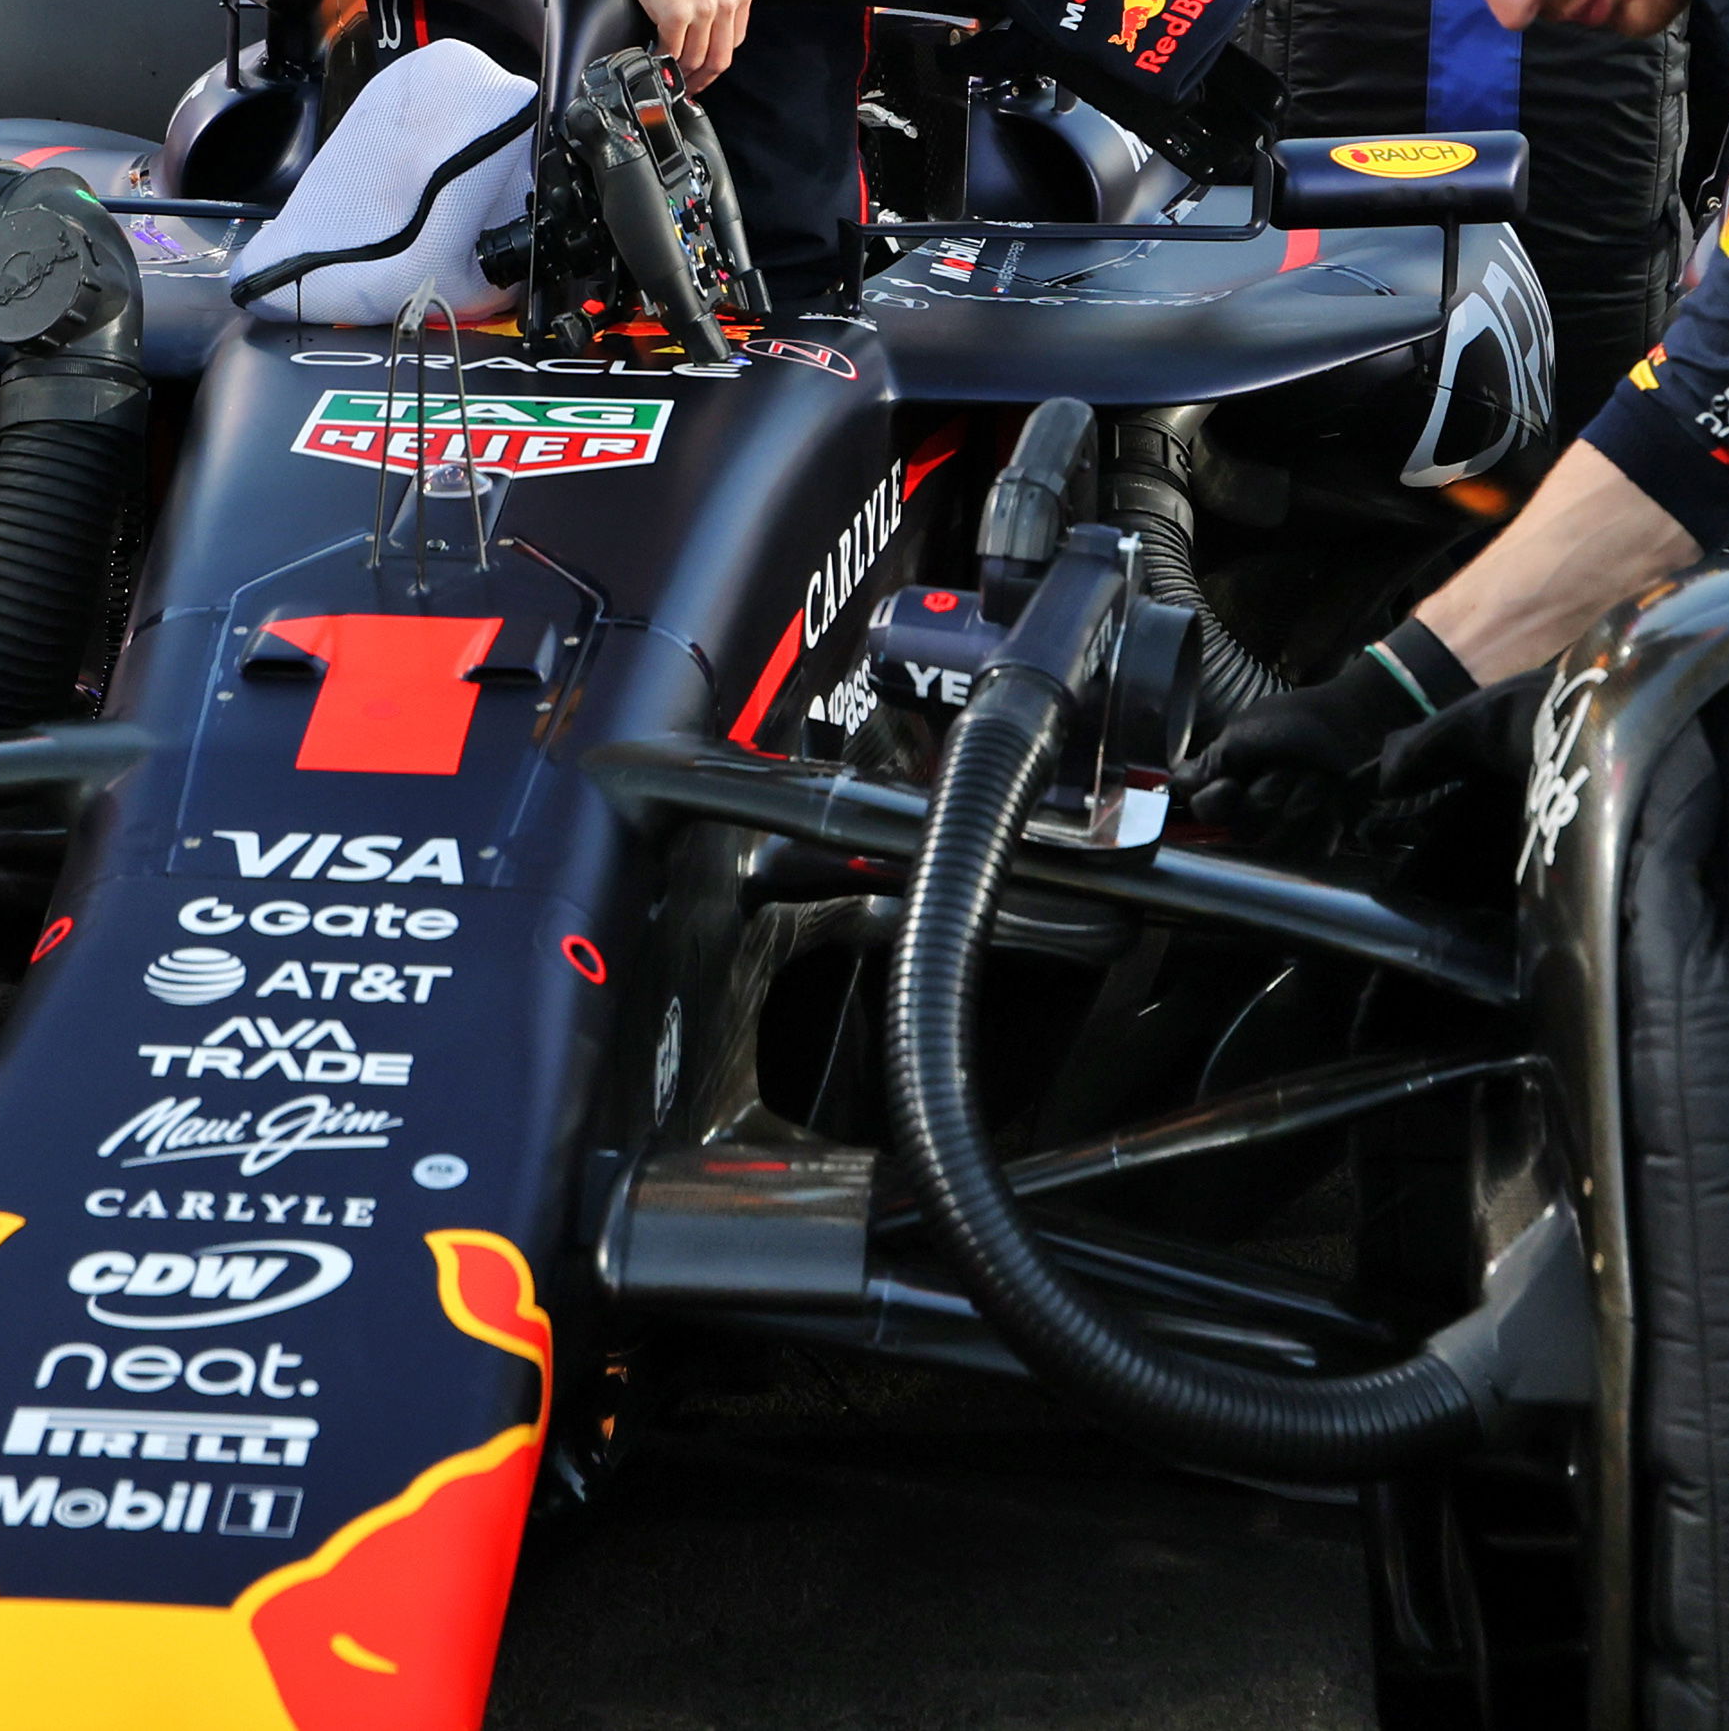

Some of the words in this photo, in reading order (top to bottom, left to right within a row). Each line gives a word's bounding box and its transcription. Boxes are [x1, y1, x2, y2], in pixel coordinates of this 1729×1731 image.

[1369, 142, 1461, 167] RAUCH
[289, 350, 753, 379] ORACLE
[350, 398, 637, 426] TAG
[319, 428, 639, 466] HEUER
[804, 457, 903, 650] CARLYLE
[259, 613, 504, 776] 1
[904, 660, 973, 707] YE
[213, 829, 465, 885] VISA
[255, 960, 453, 1004] AT&T
[202, 1016, 357, 1052] AVA
[138, 1045, 414, 1085] TRADE
[97, 1096, 252, 1158] Maui
[239, 1093, 404, 1177] Jim
[84, 1188, 377, 1227] CARLYLE
[3, 1406, 319, 1466] PIRELLI
